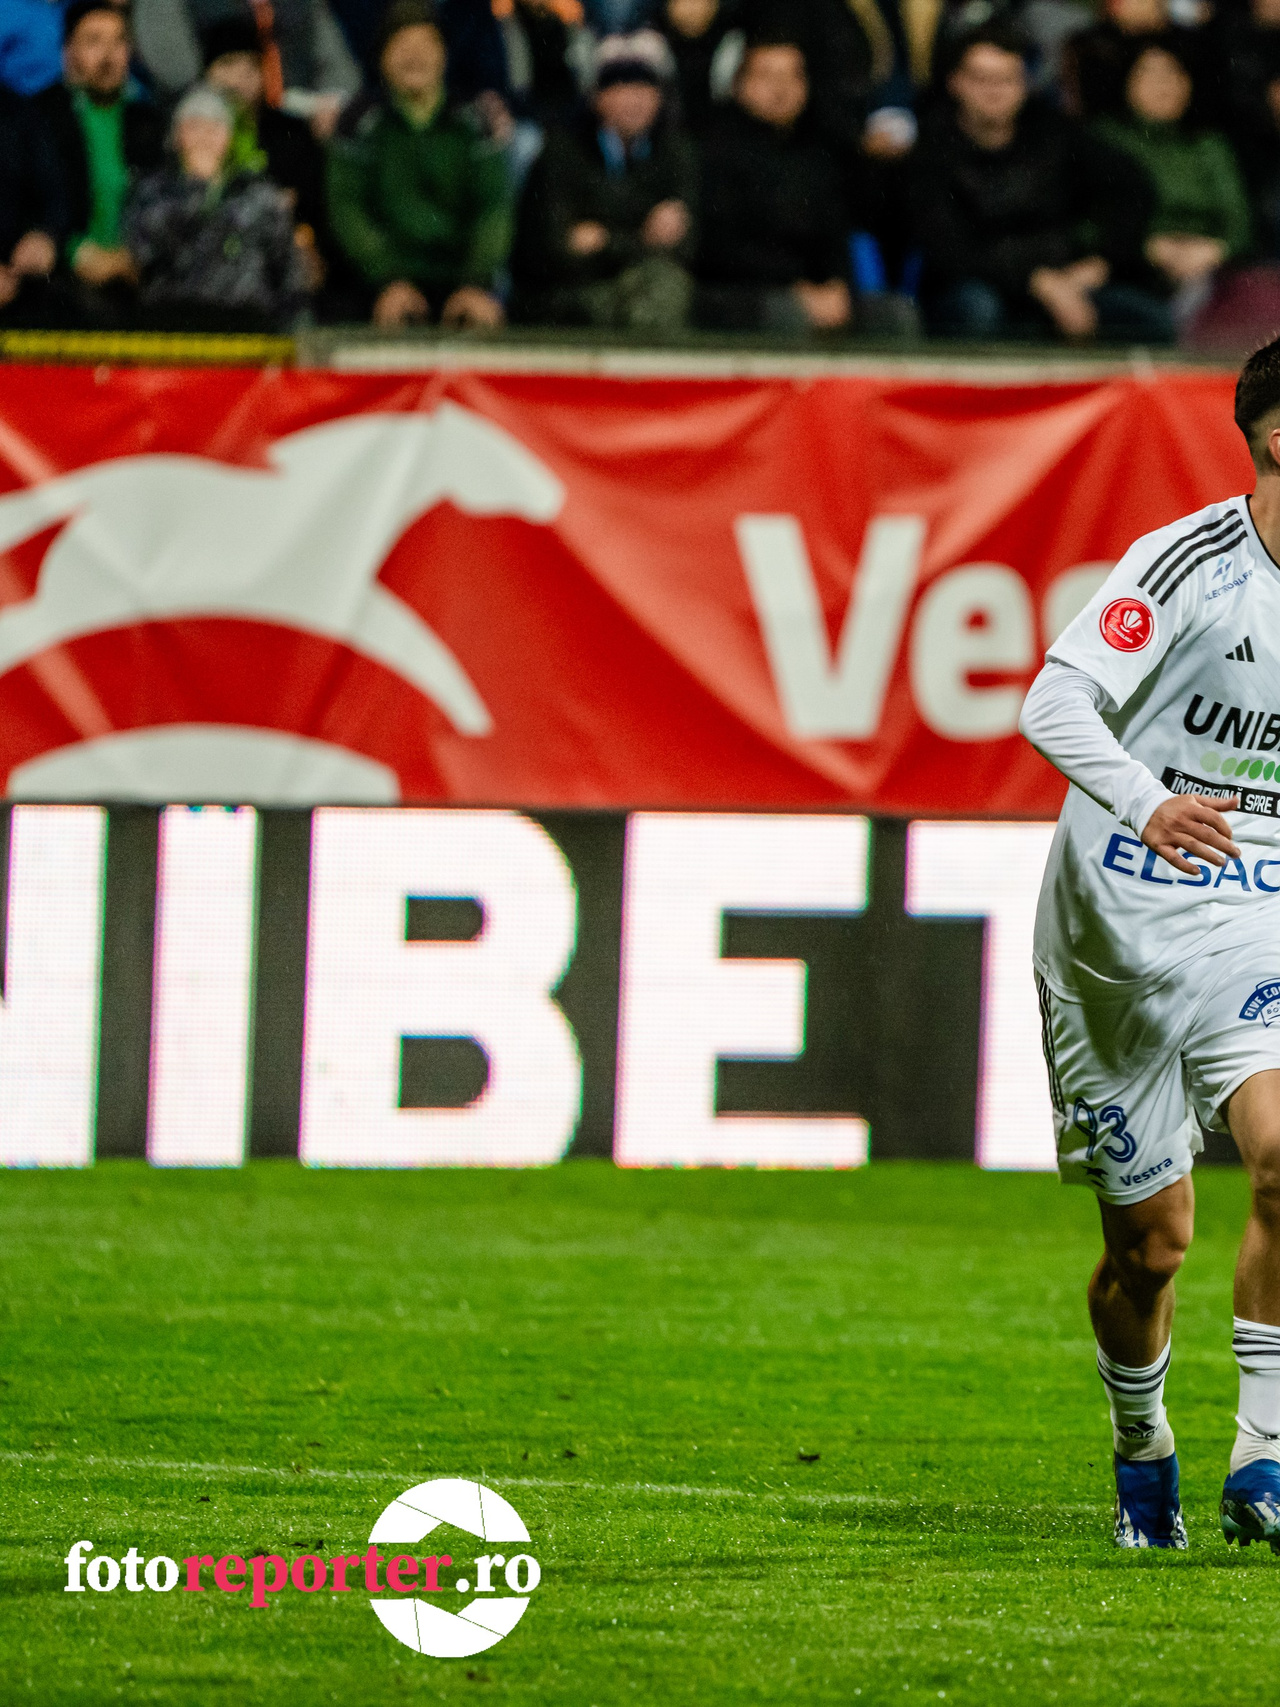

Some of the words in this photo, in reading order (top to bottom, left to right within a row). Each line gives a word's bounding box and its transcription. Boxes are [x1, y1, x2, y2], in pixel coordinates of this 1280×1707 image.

[1244, 793, 1274, 814] SPRE
[1243, 996, 1265, 1018] FIVE
[1073, 1096, 1137, 1164] 93
[1119, 1157, 1174, 1187] Vestra
